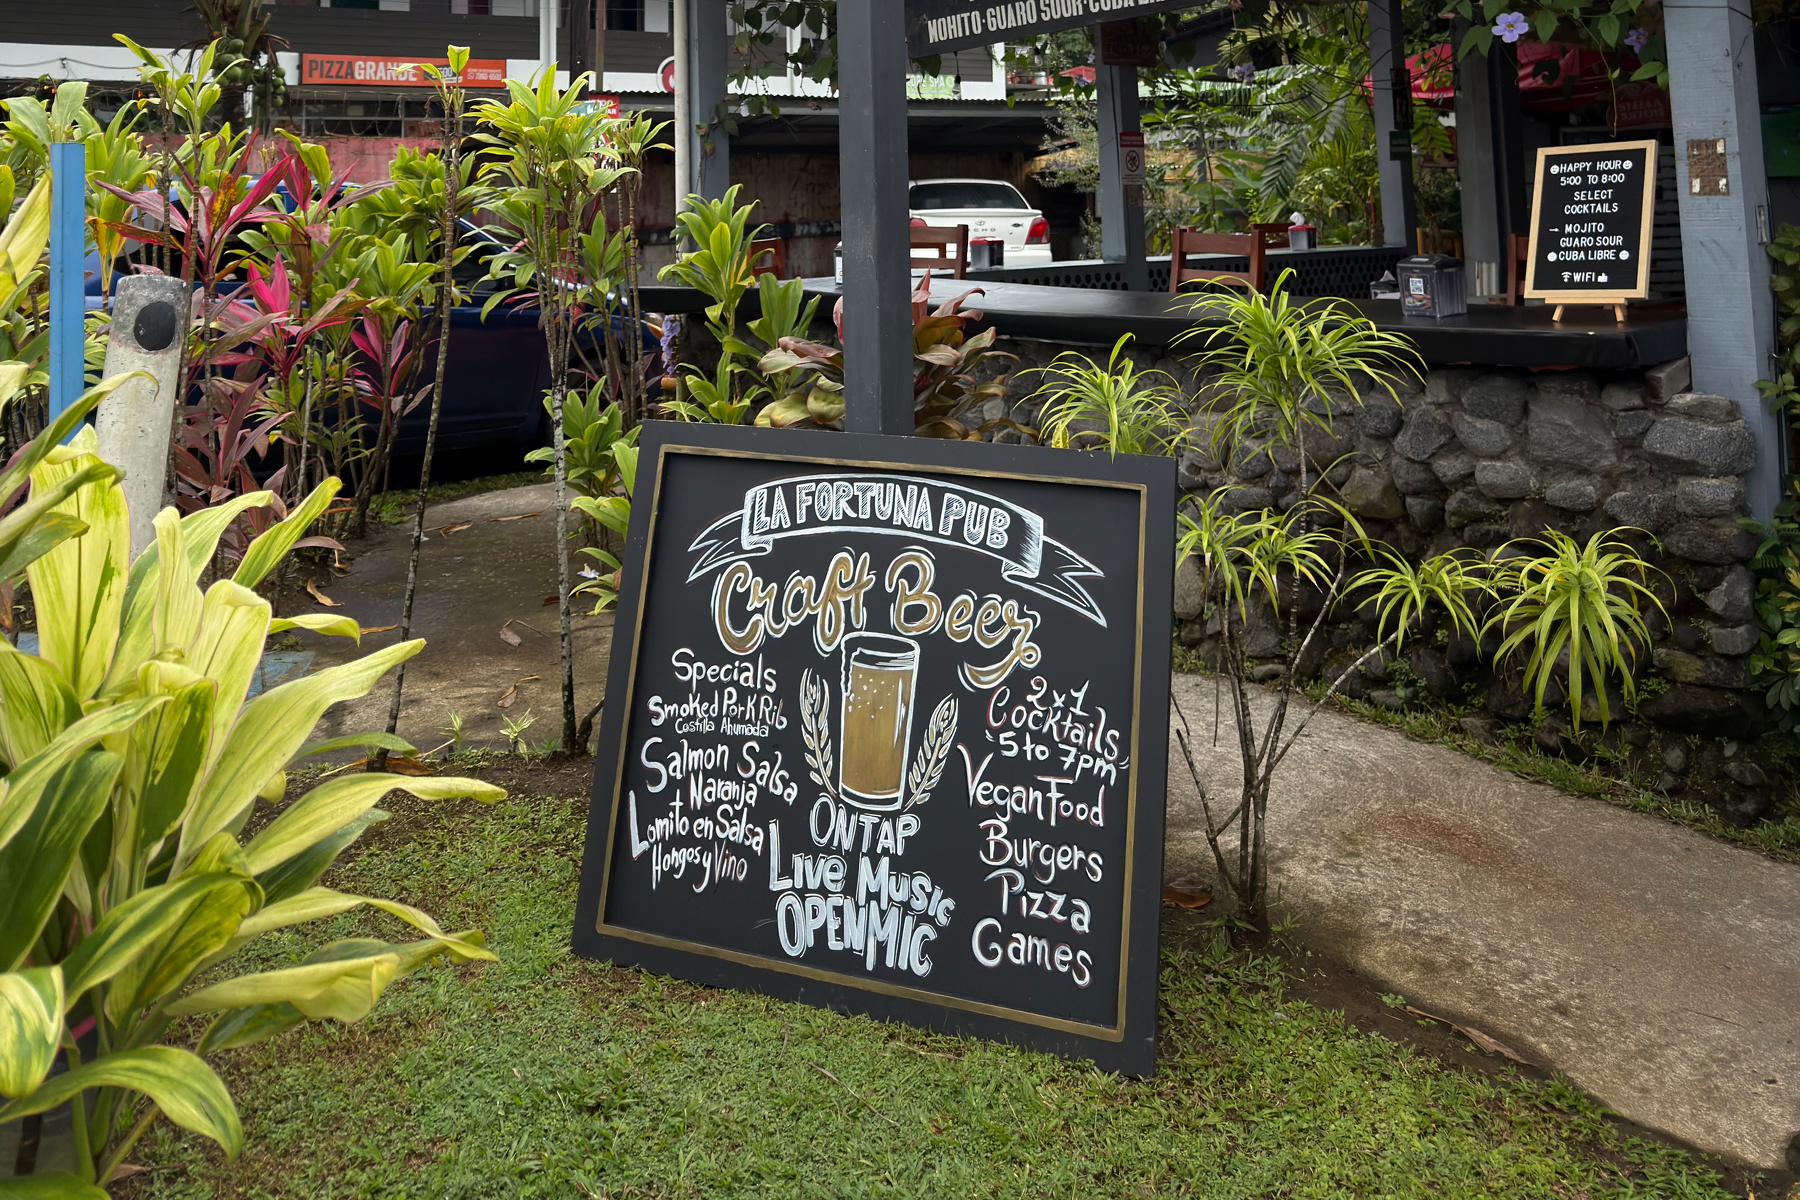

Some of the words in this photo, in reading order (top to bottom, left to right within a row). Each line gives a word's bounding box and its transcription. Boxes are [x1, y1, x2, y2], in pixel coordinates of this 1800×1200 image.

[929, 74, 946, 89] SPA
[1559, 161, 1593, 174] HAPPY
[1596, 159, 1622, 171] HOUR
[1560, 175, 1582, 186] 5:00
[1587, 174, 1598, 185] TO
[1601, 172, 1625, 184] 8:00
[1564, 202, 1619, 215] COCKTAILS
[1573, 189, 1614, 201] SELECT
[1559, 236, 1594, 248] GUARO
[1595, 235, 1623, 247] SOUR
[1564, 222, 1605, 234] MOJITO
[1558, 250, 1585, 261] CUBA
[1587, 249, 1617, 261] LIBRE
[1573, 271, 1596, 283] WIFI
[752, 485, 791, 535] LA
[795, 480, 933, 532] FORTUNA
[938, 492, 1011, 550] PUB
[713, 548, 877, 656] Craft
[885, 548, 1042, 688] Beer
[671, 647, 777, 694] Specials
[674, 716, 715, 735] Costilla
[720, 716, 769, 738] Ahumada
[758, 694, 788, 730] Rib
[986, 685, 1120, 762] Cocktails
[1022, 731, 1050, 761] to
[640, 736, 730, 793] Salmon
[736, 739, 798, 806] Salsa
[689, 769, 758, 811] Naranja
[628, 787, 690, 861] Lomito
[692, 816, 714, 841] en
[715, 803, 765, 857] Salsa
[651, 841, 703, 892] Hongos
[713, 839, 748, 887] Vino
[978, 818, 1103, 885] Burgers
[984, 867, 1092, 935] Pizza
[971, 917, 1093, 990] Games
